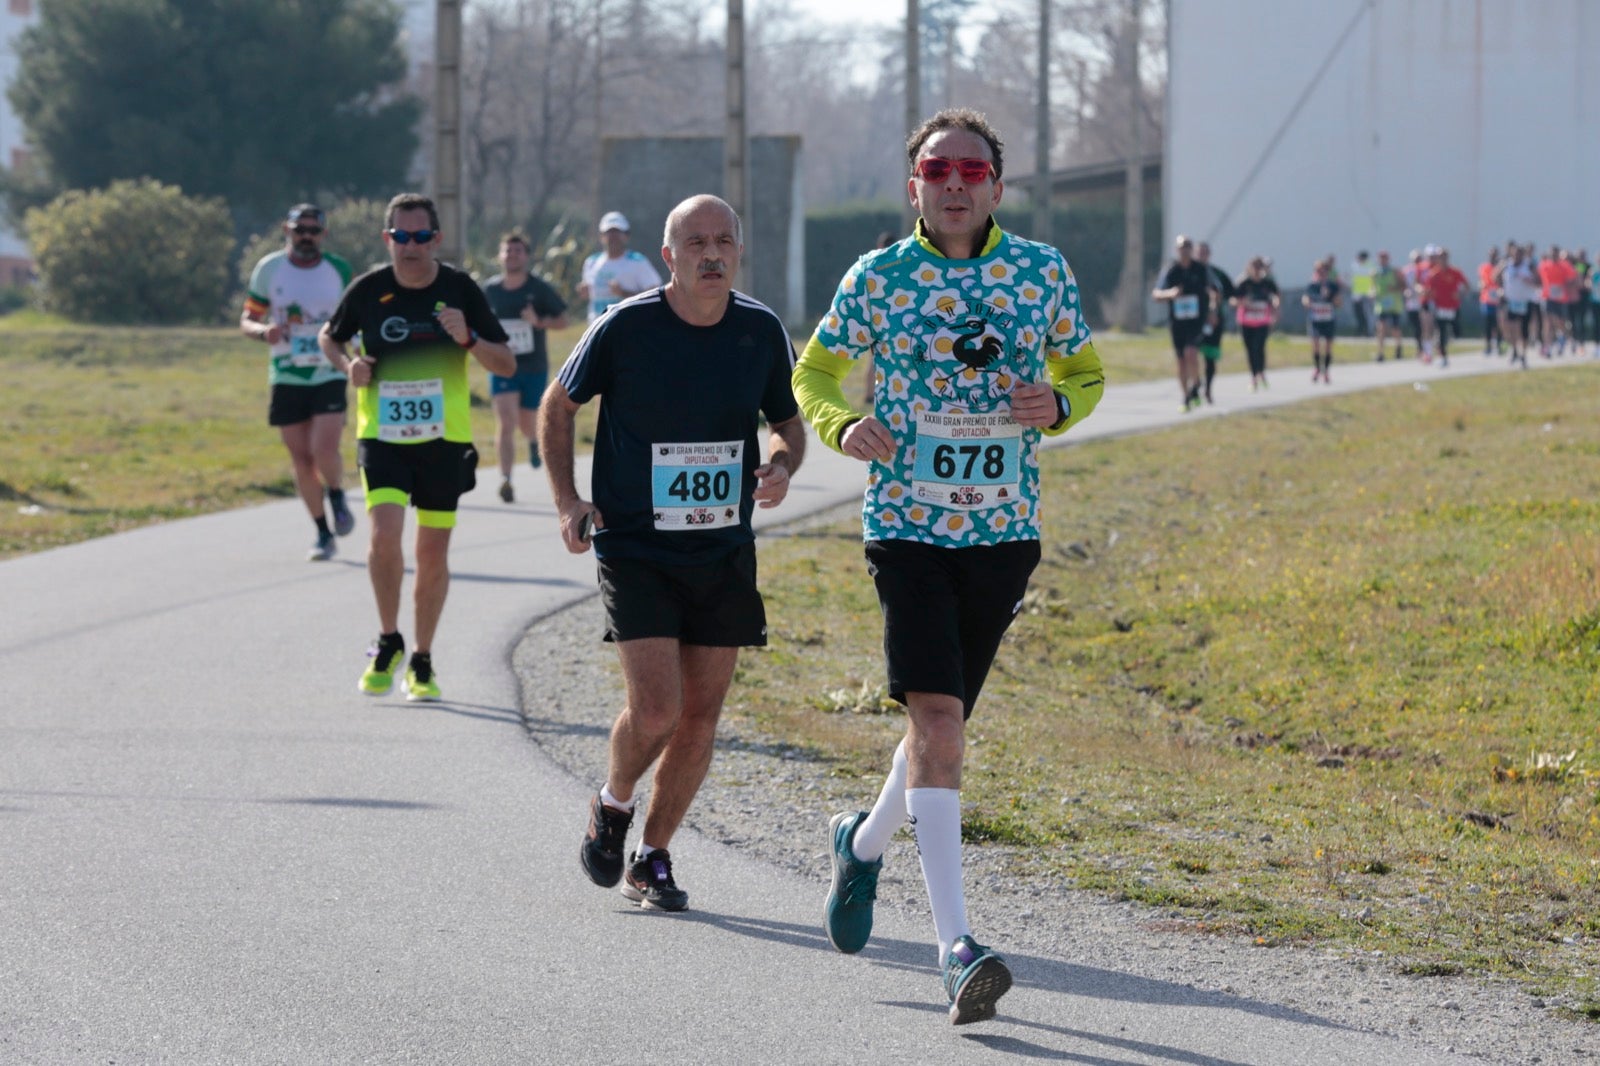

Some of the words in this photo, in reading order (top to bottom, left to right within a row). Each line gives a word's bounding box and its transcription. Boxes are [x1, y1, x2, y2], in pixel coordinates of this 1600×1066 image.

[389, 400, 433, 421] 339
[943, 416, 961, 426] GRAN
[962, 416, 987, 426] PREMIO
[988, 416, 996, 426] DE
[676, 447, 693, 455] GRAN
[694, 447, 715, 455] PREMIO
[716, 446, 724, 454] DE
[933, 444, 1005, 479] 678
[668, 471, 730, 502] 480
